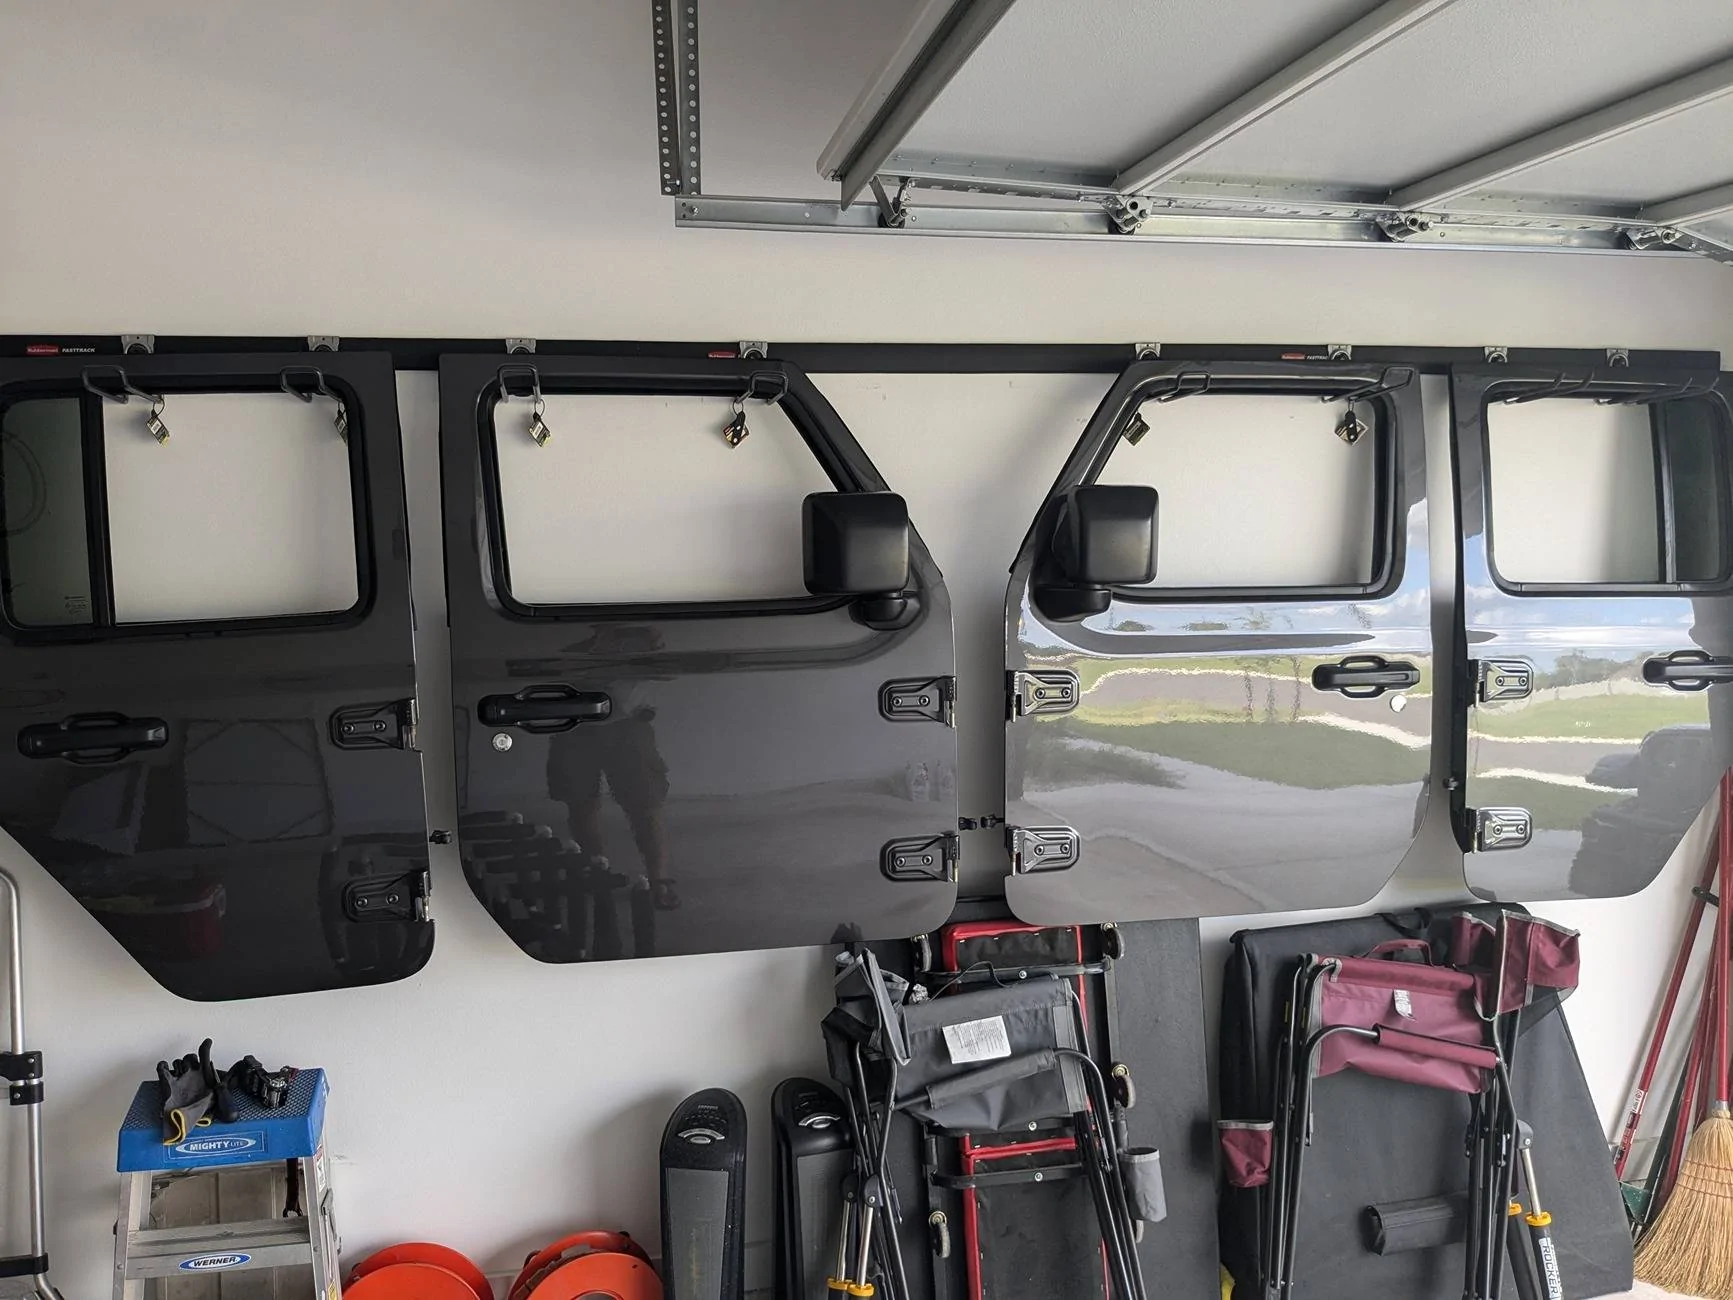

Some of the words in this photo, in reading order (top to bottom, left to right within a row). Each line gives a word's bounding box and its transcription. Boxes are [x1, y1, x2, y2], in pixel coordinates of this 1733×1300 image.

[189, 1140, 229, 1151] MIGHTY
[193, 1256, 236, 1267] WERNER
[1542, 1245, 1559, 1294] ROCKER
